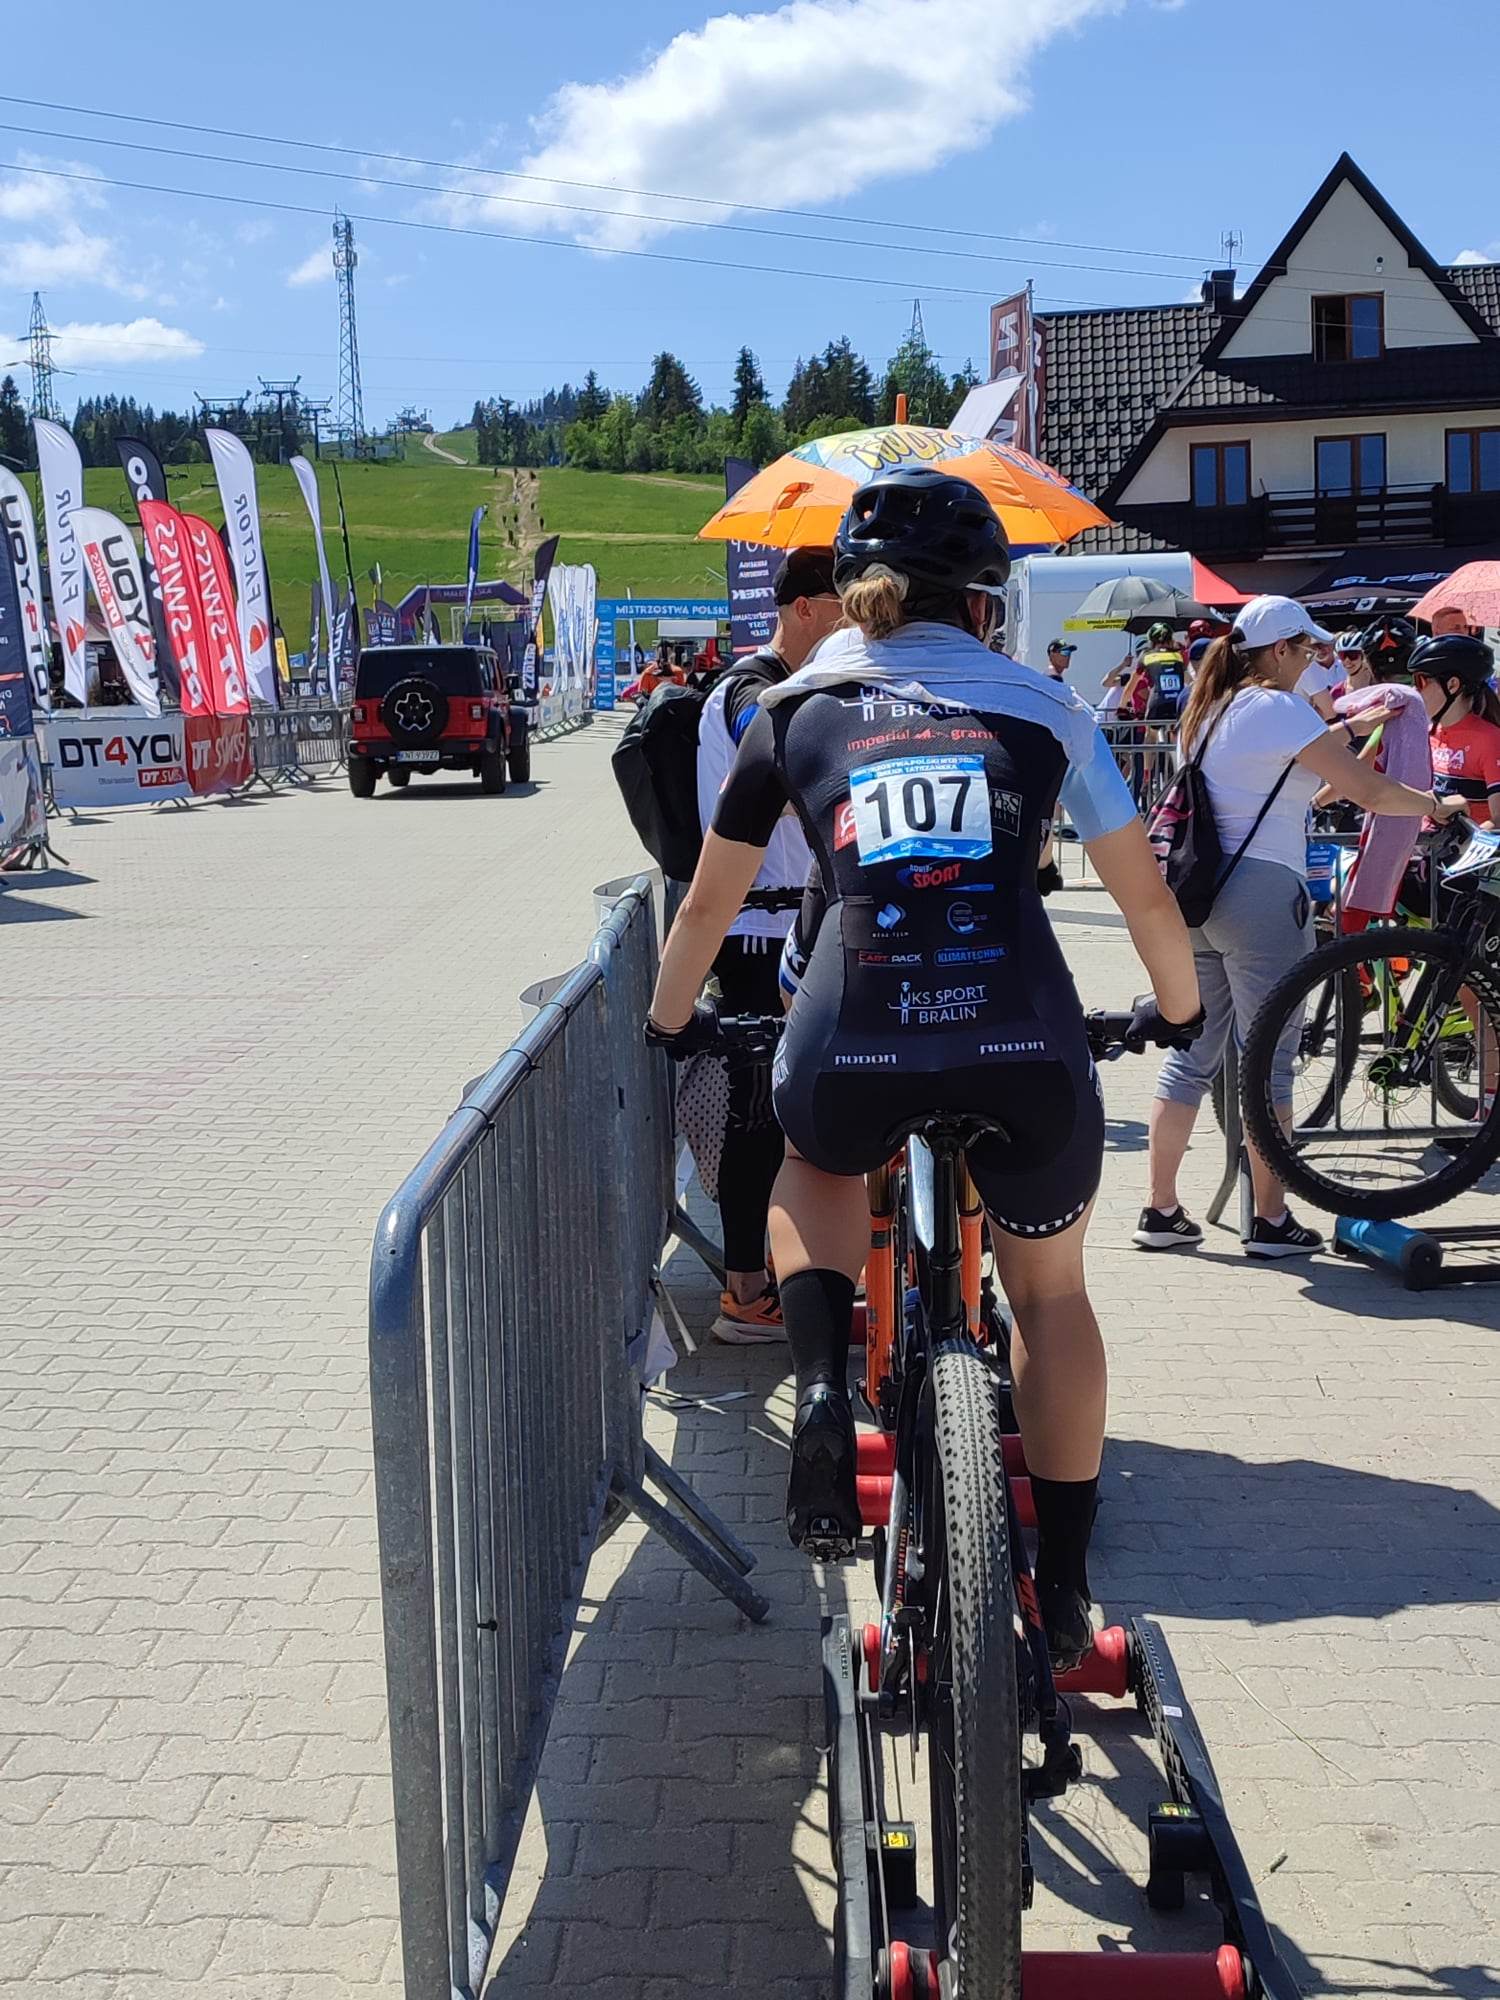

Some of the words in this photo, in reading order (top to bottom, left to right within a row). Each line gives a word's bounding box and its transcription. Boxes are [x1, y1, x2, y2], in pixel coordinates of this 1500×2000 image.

[1331, 572, 1452, 587] SUPER
[615, 605, 689, 615] MISTRZOSTWA
[692, 605, 729, 615] POLSKI
[1162, 676, 1180, 689] 101
[891, 703, 984, 718] BRALI
[58, 733, 183, 769] DT4YOU
[865, 775, 971, 840] 107
[912, 863, 961, 888] SPORT
[935, 985, 988, 1003] SPORT
[918, 1005, 978, 1024] BRALIN
